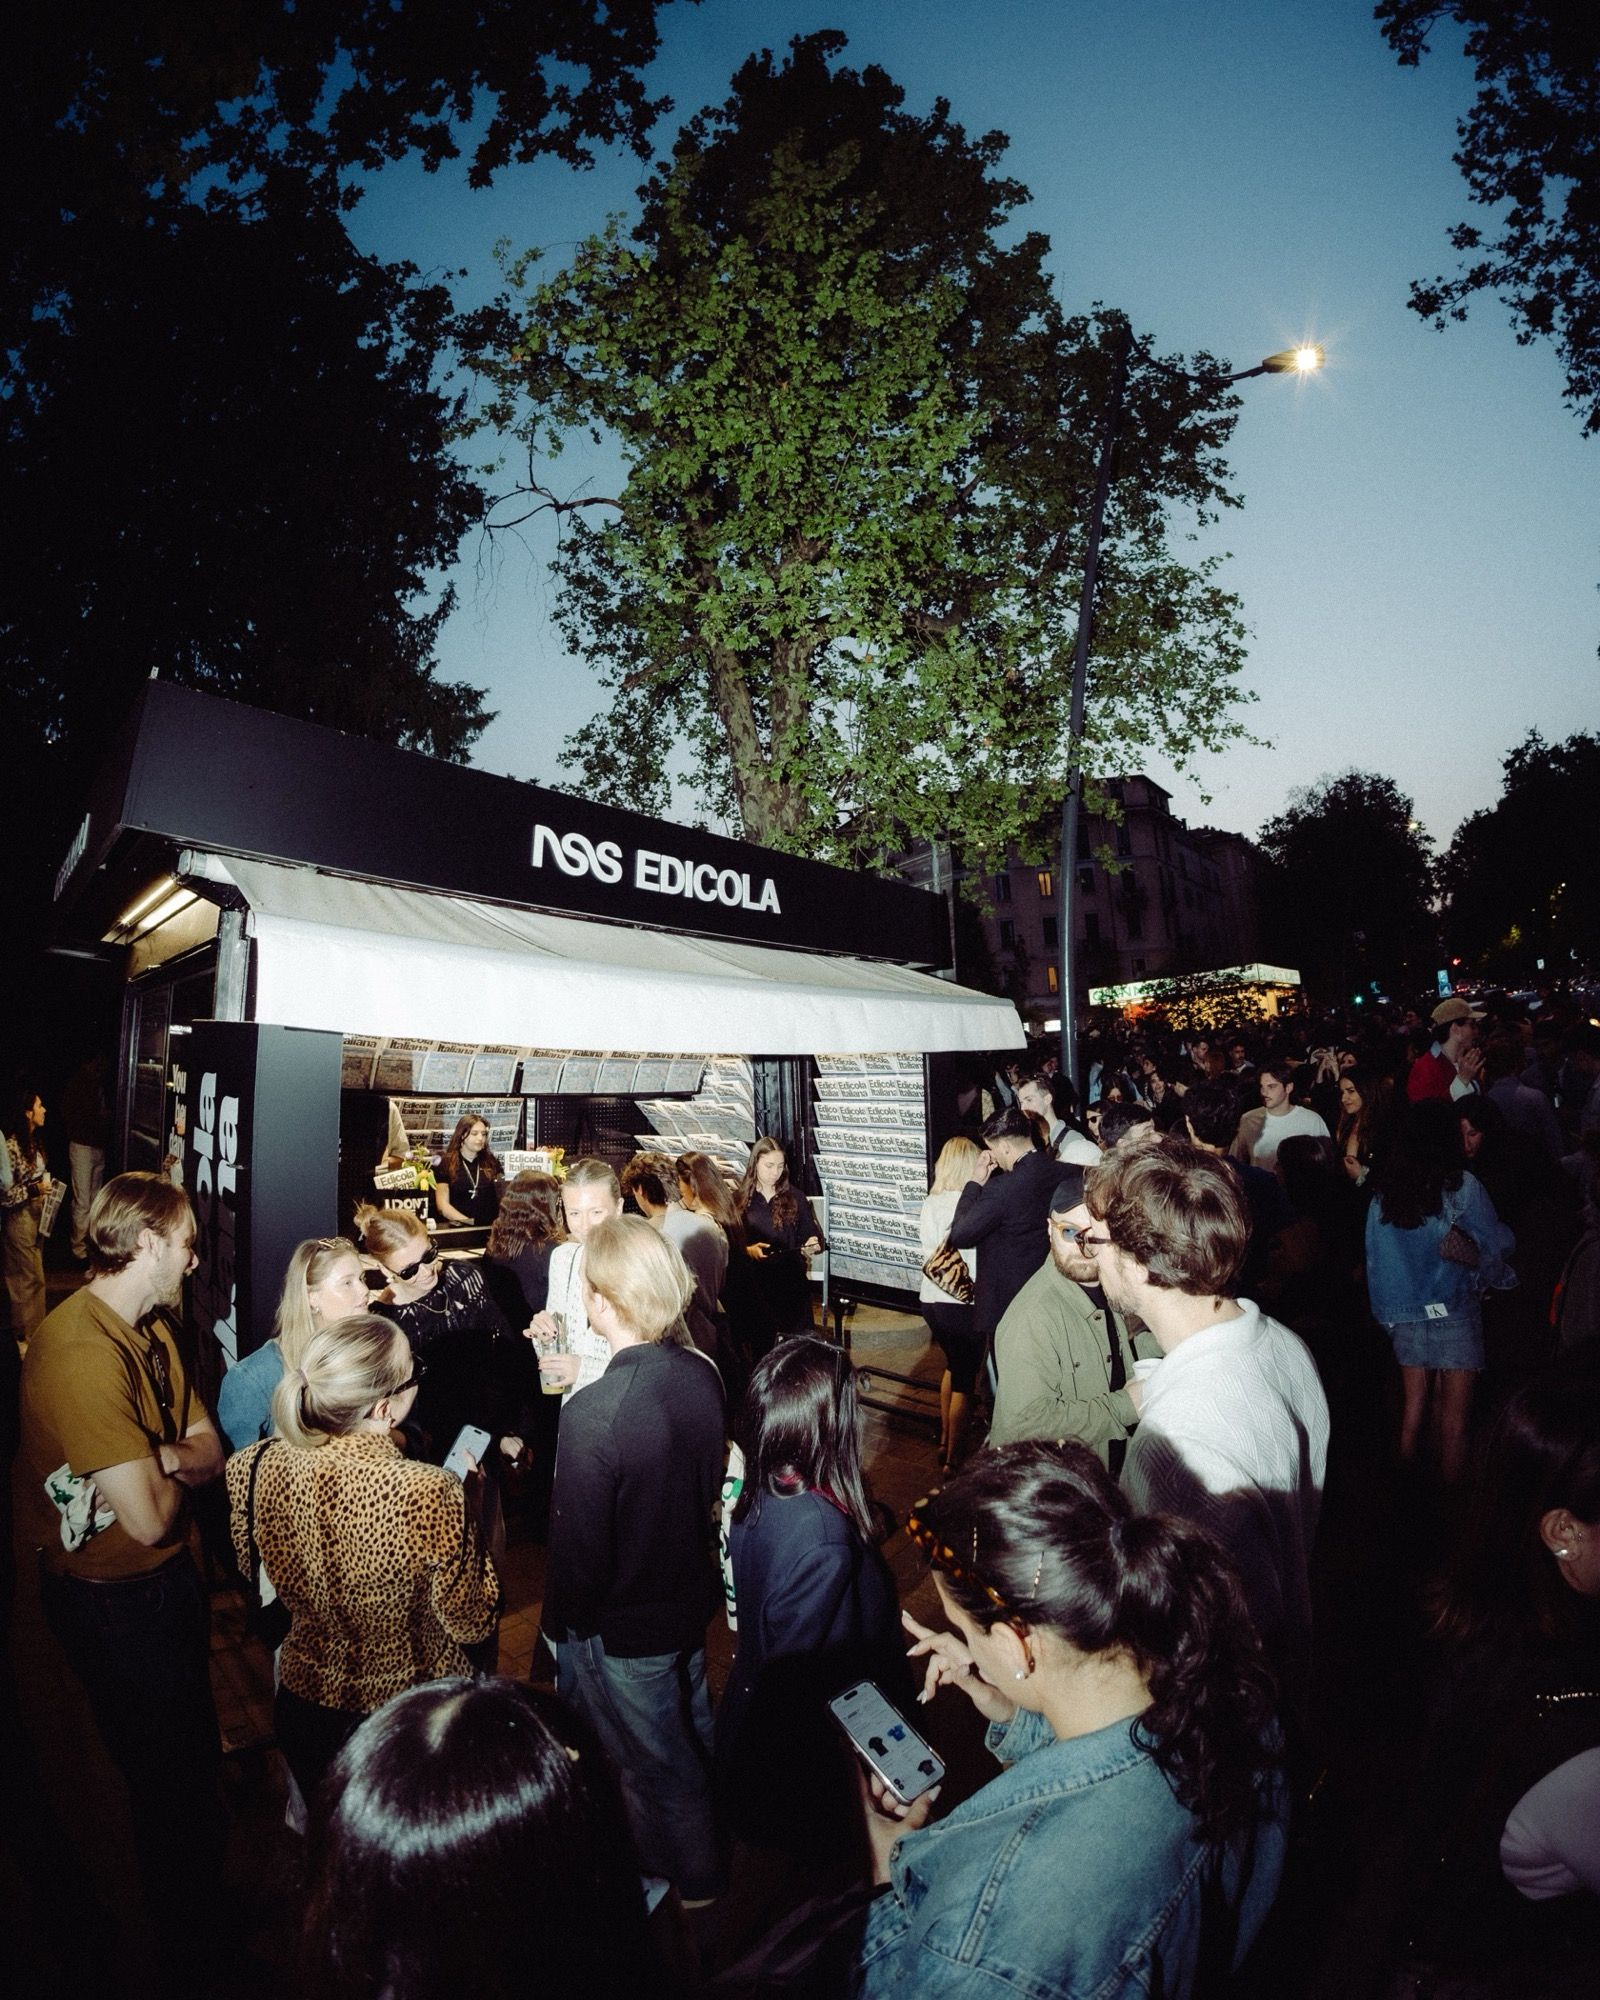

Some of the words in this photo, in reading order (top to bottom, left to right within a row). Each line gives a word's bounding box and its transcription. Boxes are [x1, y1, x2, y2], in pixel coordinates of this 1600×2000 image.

[634, 849, 782, 914] EDICOLA
[838, 1081, 867, 1089] Edicola
[841, 1089, 868, 1097] Italiana
[868, 1107, 896, 1115] Edicola
[870, 1115, 898, 1123] Italiana
[509, 1154, 544, 1163] Edicola
[380, 1170, 415, 1186] Edicola
[872, 1216, 900, 1227] Edicola
[873, 1243, 902, 1255] Edicola
